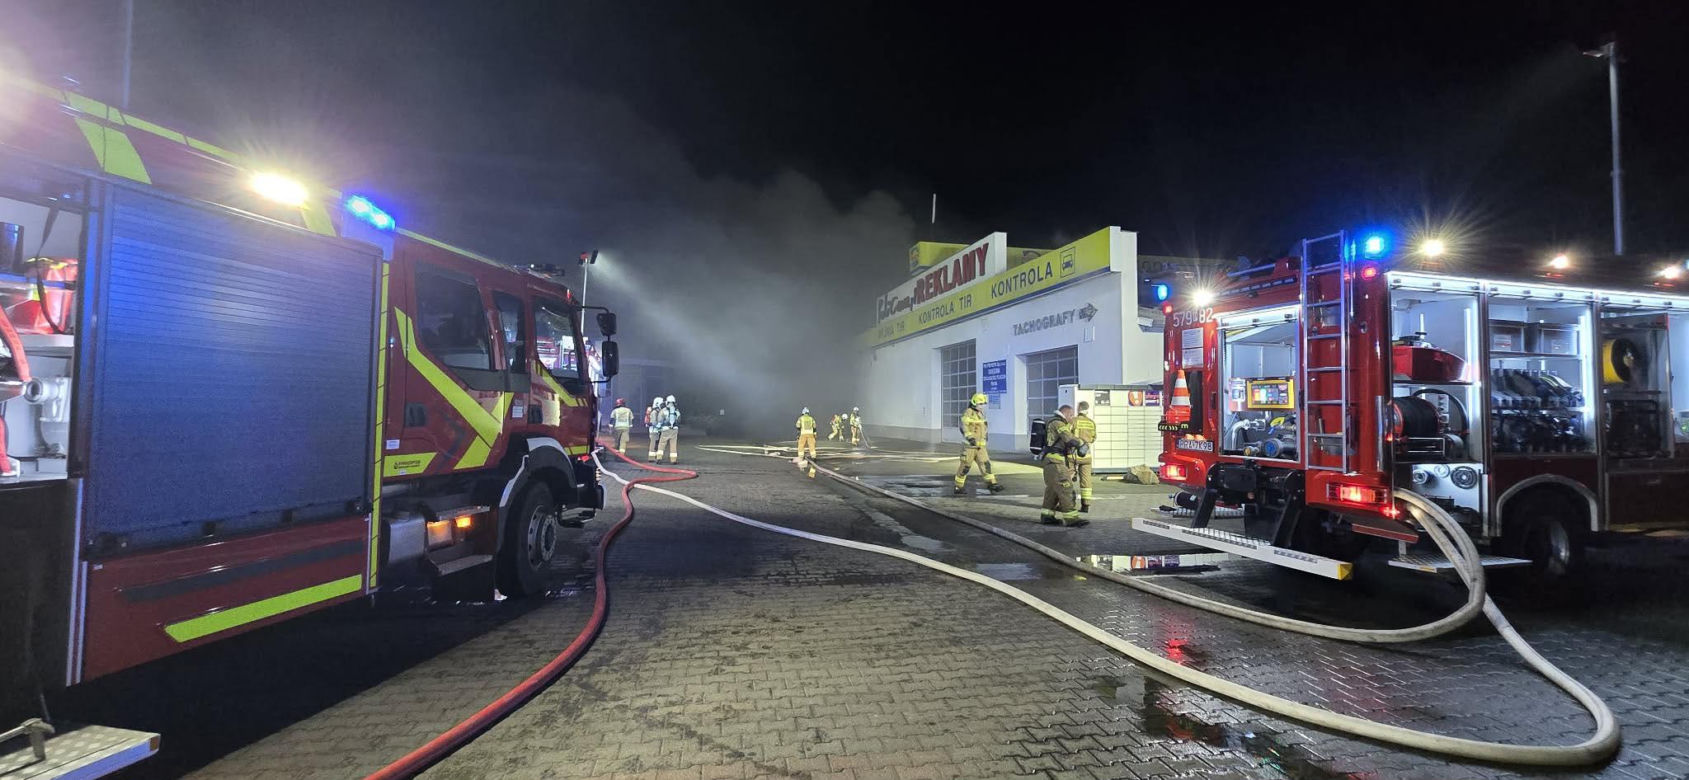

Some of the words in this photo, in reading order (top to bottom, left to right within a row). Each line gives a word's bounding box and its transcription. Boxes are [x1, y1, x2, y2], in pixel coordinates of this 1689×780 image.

[914, 243, 989, 304] REKLAMY
[991, 261, 1053, 299] KONTROLA
[919, 301, 954, 325] KONTROLA
[959, 294, 972, 310] TIR
[1013, 308, 1076, 336] TACHOGRAFY
